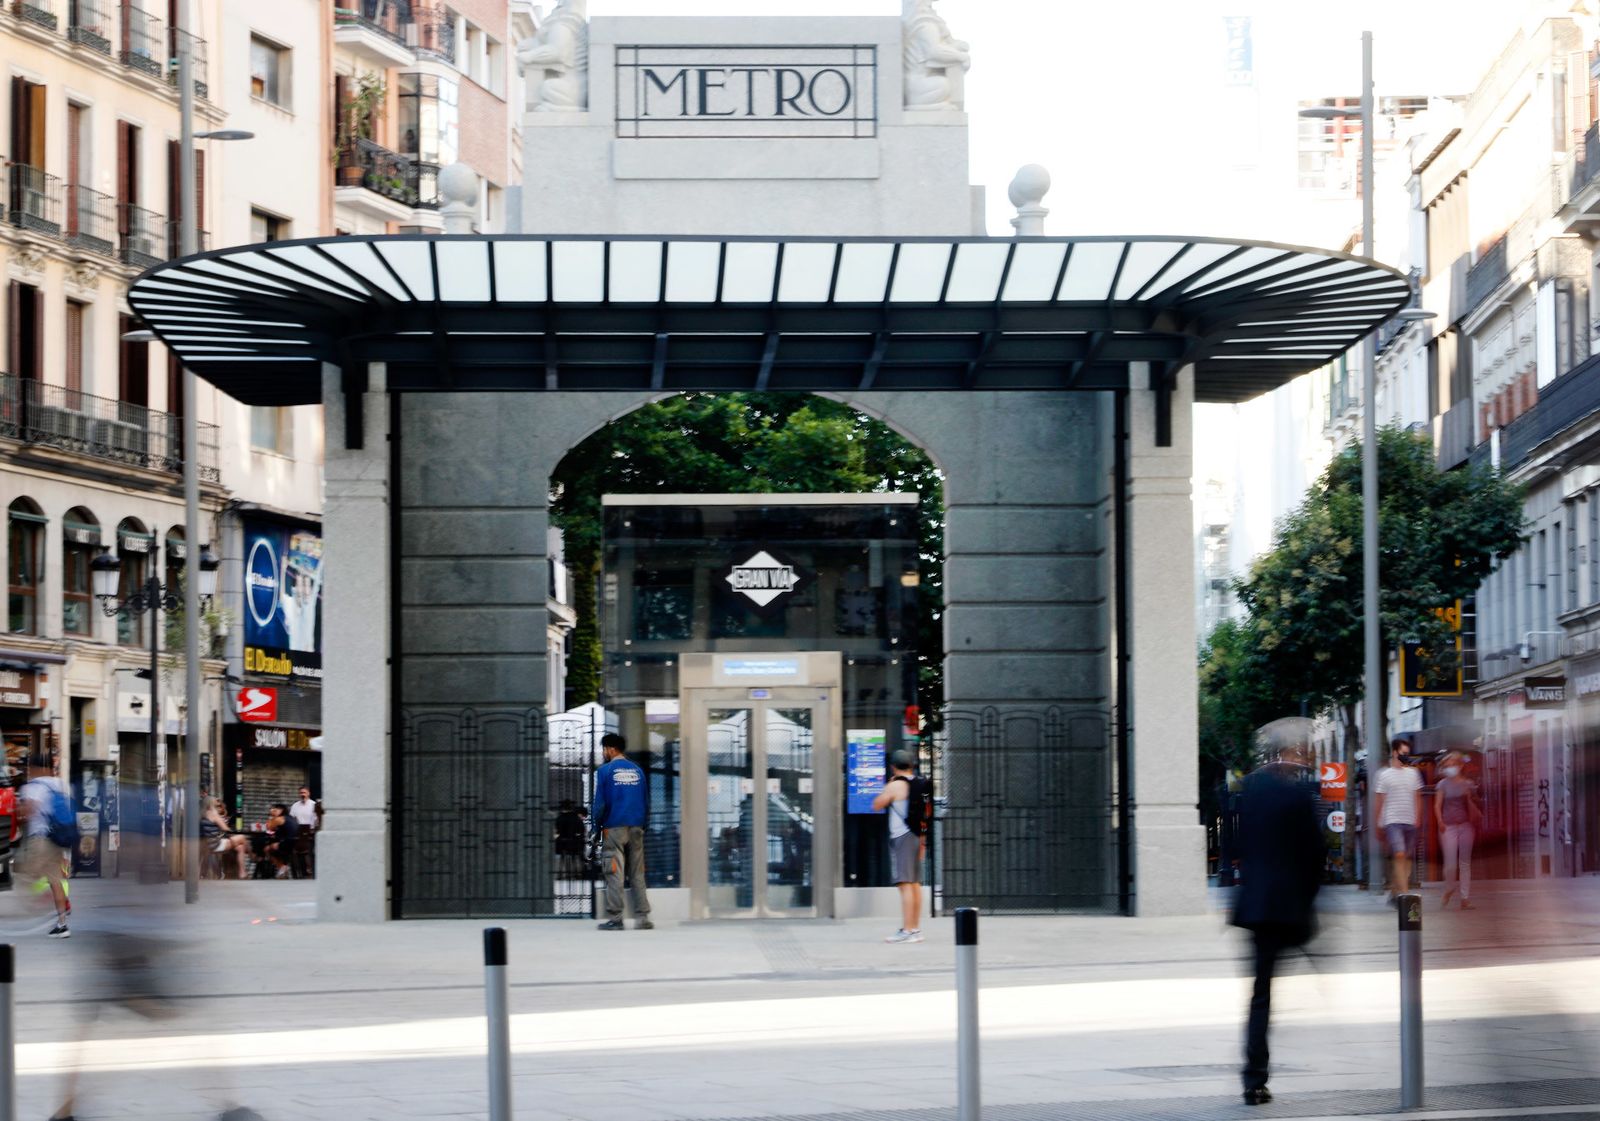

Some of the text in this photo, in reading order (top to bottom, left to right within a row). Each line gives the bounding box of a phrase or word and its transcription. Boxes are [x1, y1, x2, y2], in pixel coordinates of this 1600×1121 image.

[641, 68, 852, 117] METRO
[735, 568, 769, 588] GRAN
[1525, 686, 1563, 700] VANS
